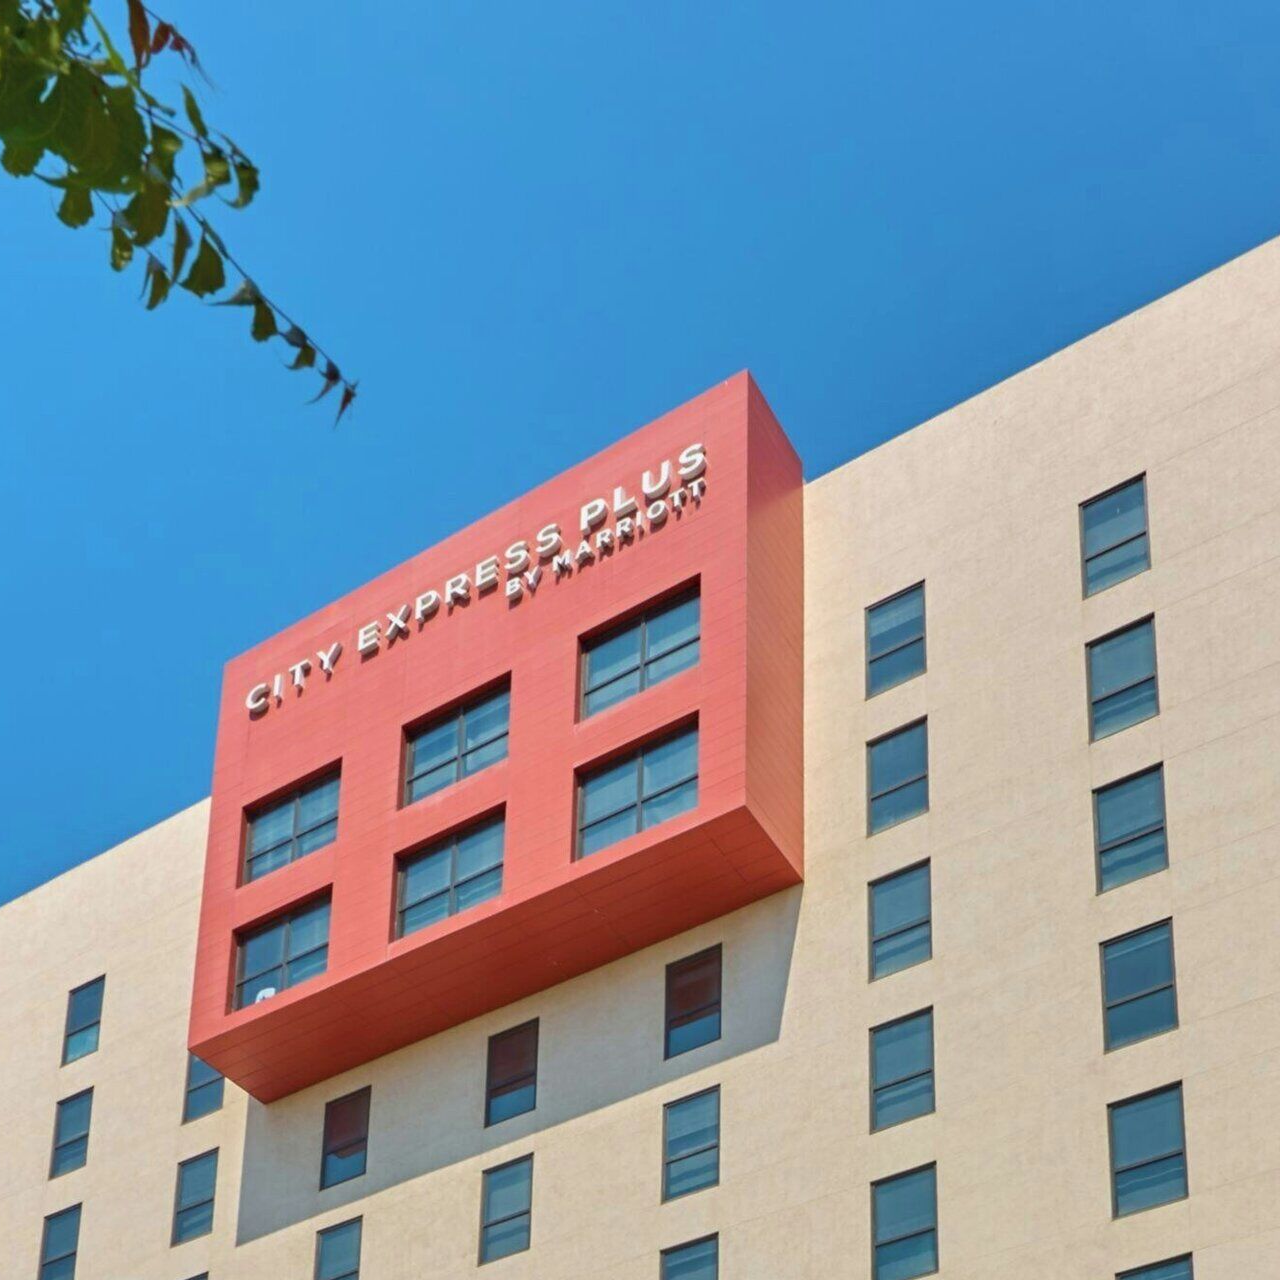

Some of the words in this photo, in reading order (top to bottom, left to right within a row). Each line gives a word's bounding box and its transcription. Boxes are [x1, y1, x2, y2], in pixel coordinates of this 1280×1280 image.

[245, 642, 343, 713] CITY
[357, 523, 563, 656] EXPRESS
[580, 443, 708, 535] PLUS
[506, 566, 542, 600] BY
[552, 477, 707, 574] MARRIOTT
